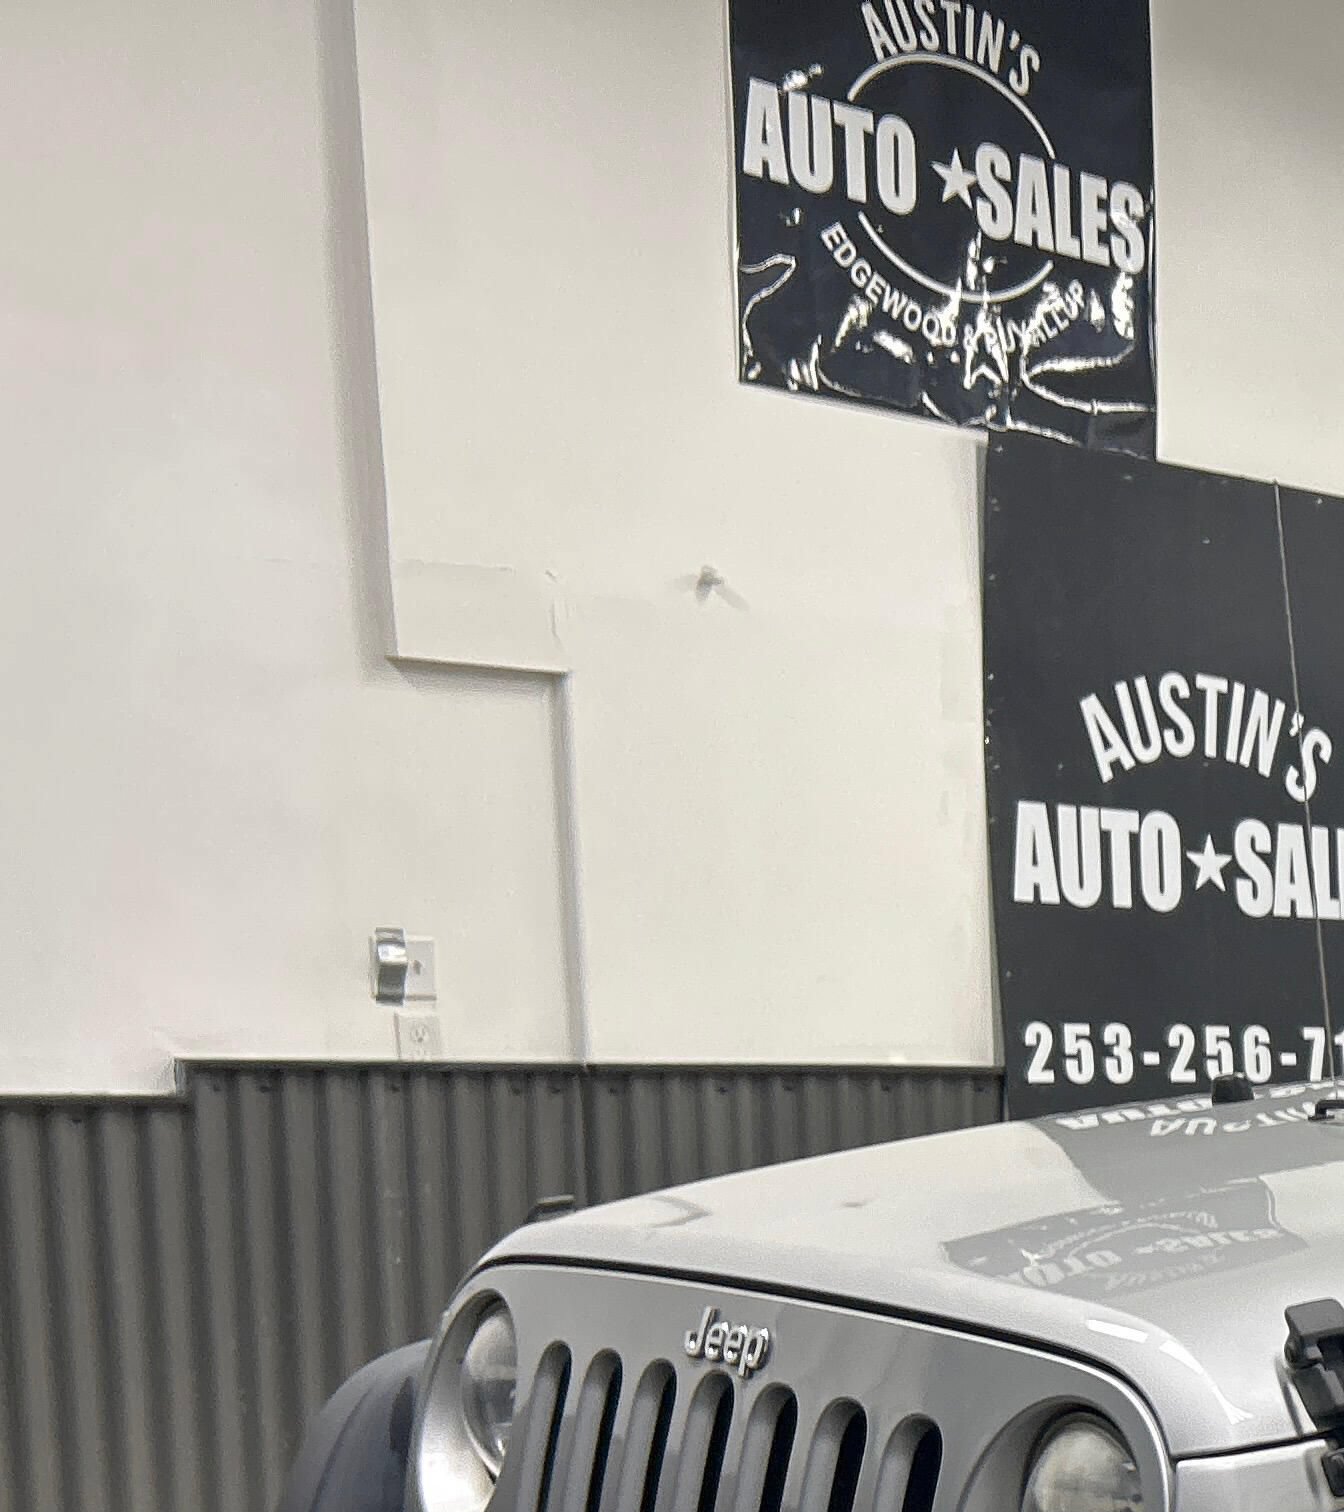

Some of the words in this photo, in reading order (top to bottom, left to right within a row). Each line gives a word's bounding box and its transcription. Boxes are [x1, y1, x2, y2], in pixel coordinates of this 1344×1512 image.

[861, 0, 1041, 97] AUSTIN'S
[743, 77, 916, 215] AUTO
[974, 142, 1146, 274] SALES
[820, 222, 957, 347] EDGEWOOD
[1080, 672, 1333, 801] AUSTIN'S
[1013, 800, 1183, 913] AUTO
[684, 1305, 769, 1377] Jeep
